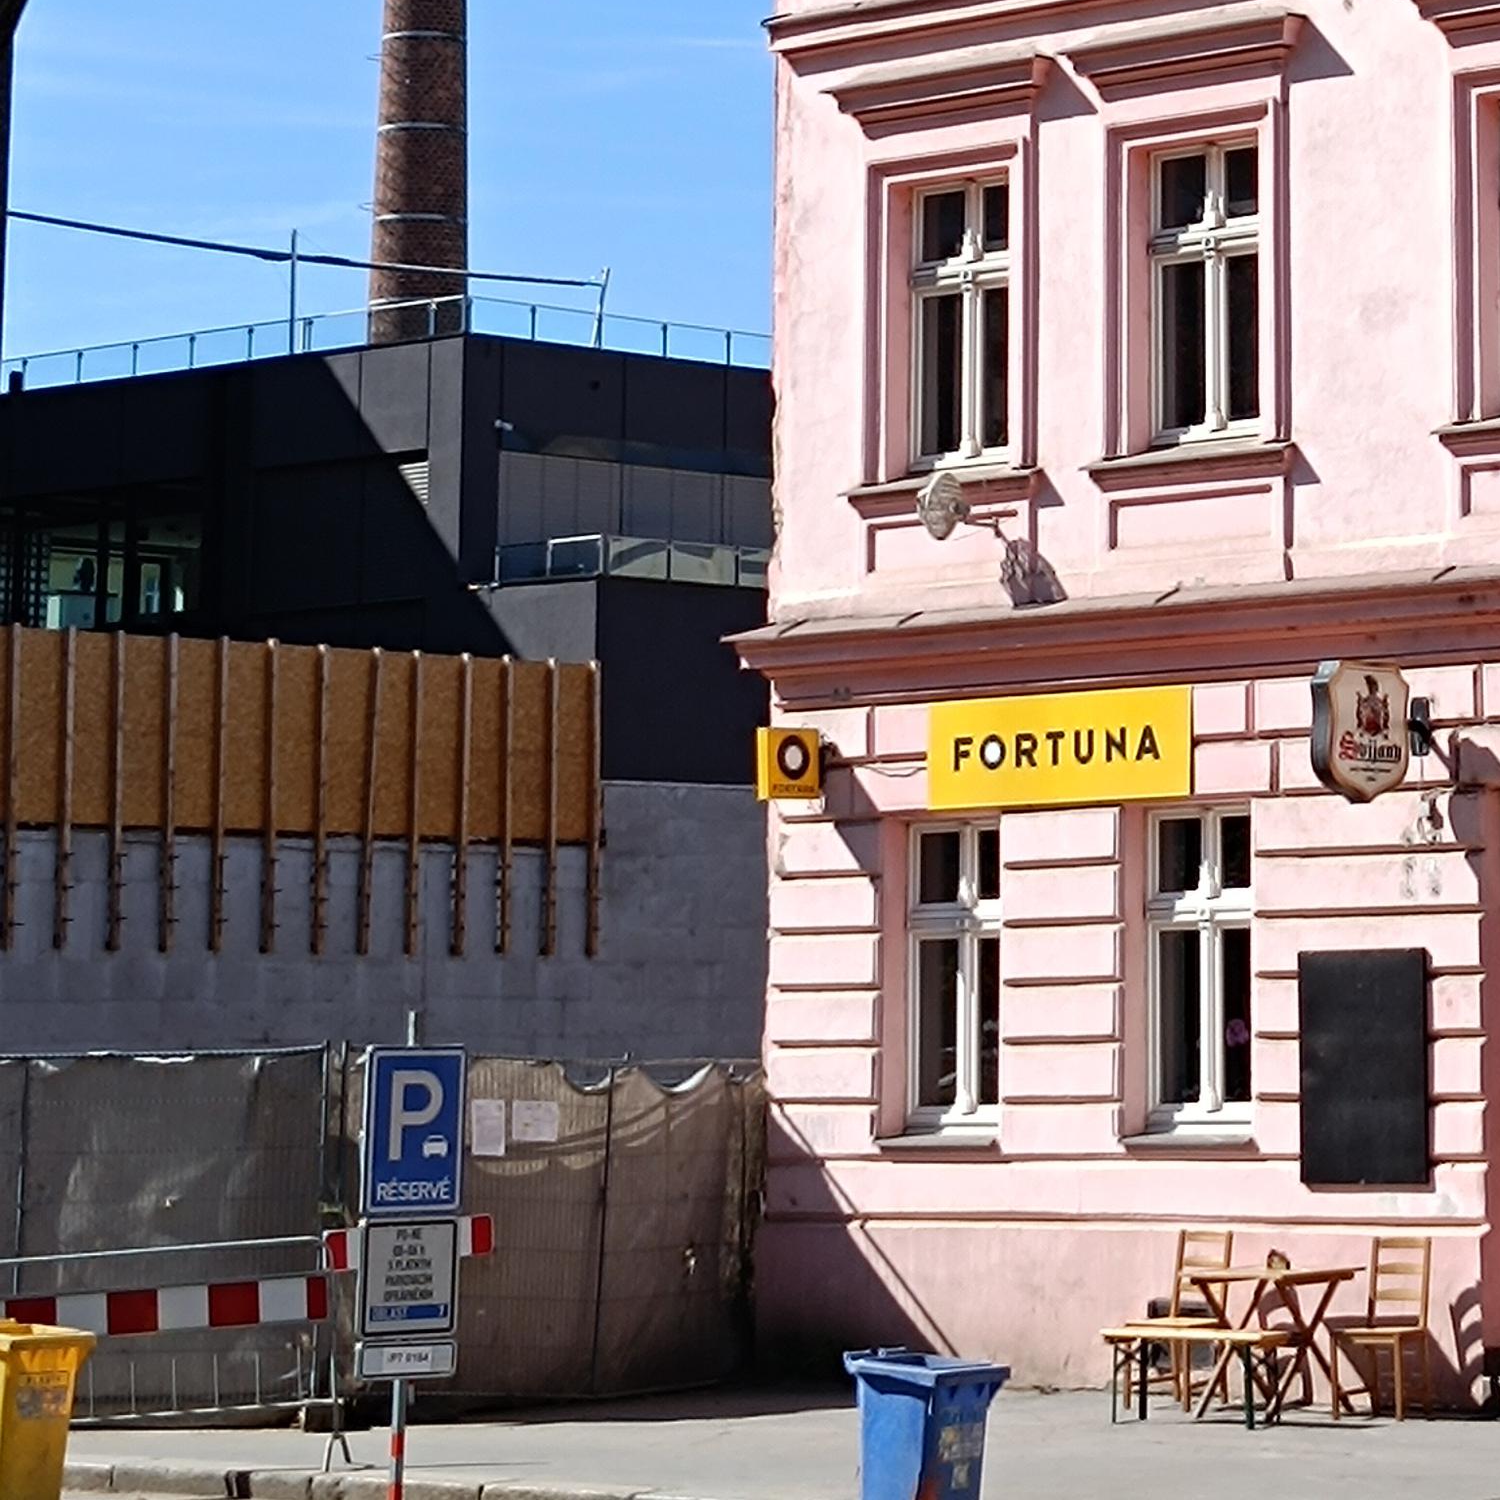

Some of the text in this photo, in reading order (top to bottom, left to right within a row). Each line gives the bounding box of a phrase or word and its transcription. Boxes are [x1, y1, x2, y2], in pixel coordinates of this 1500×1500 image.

[953, 725, 1160, 772] FORTUNA
[389, 1069, 443, 1161] P
[376, 1176, 451, 1201] RÉSERVÉ
